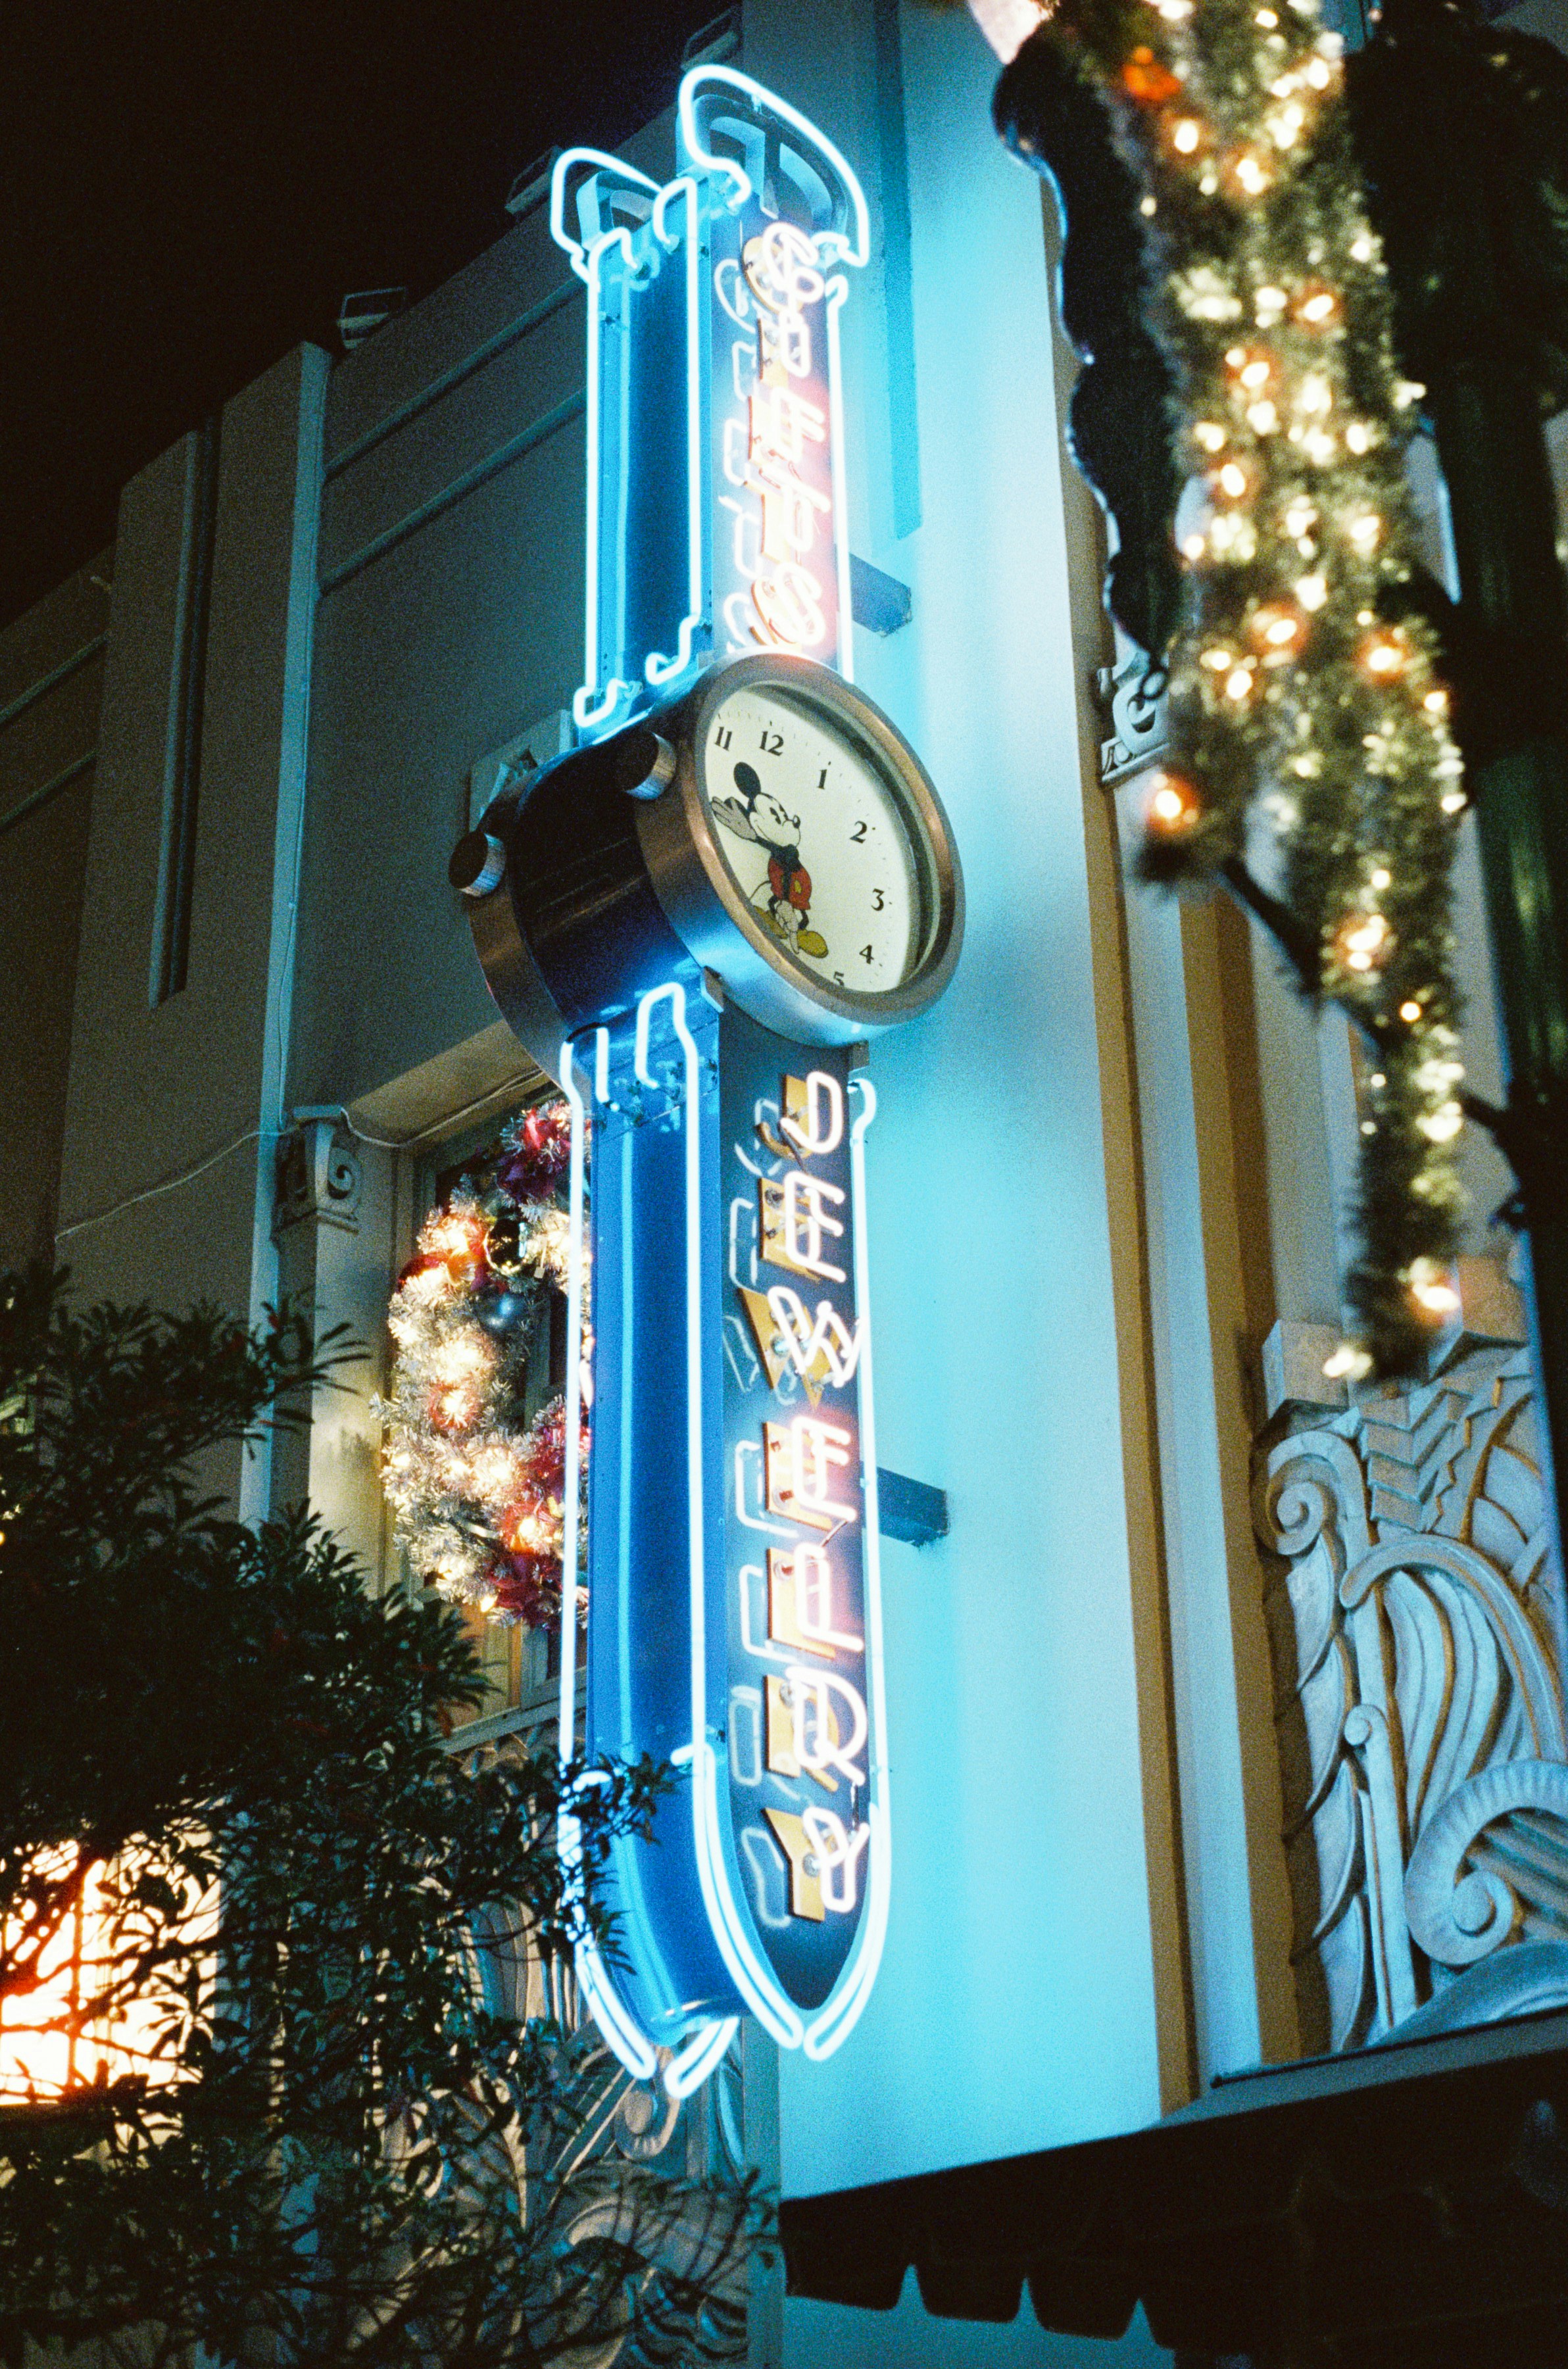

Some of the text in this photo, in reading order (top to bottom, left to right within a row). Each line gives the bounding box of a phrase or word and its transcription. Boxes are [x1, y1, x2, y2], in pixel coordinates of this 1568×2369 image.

[743, 222, 831, 650] GIFTS
[715, 726, 733, 751] 11
[759, 731, 784, 756] 12
[818, 768, 827, 790] 1
[850, 821, 868, 843] 2
[871, 889, 885, 911] 3
[860, 944, 874, 964] 4
[739, 1069, 870, 1921] JEWELRY
